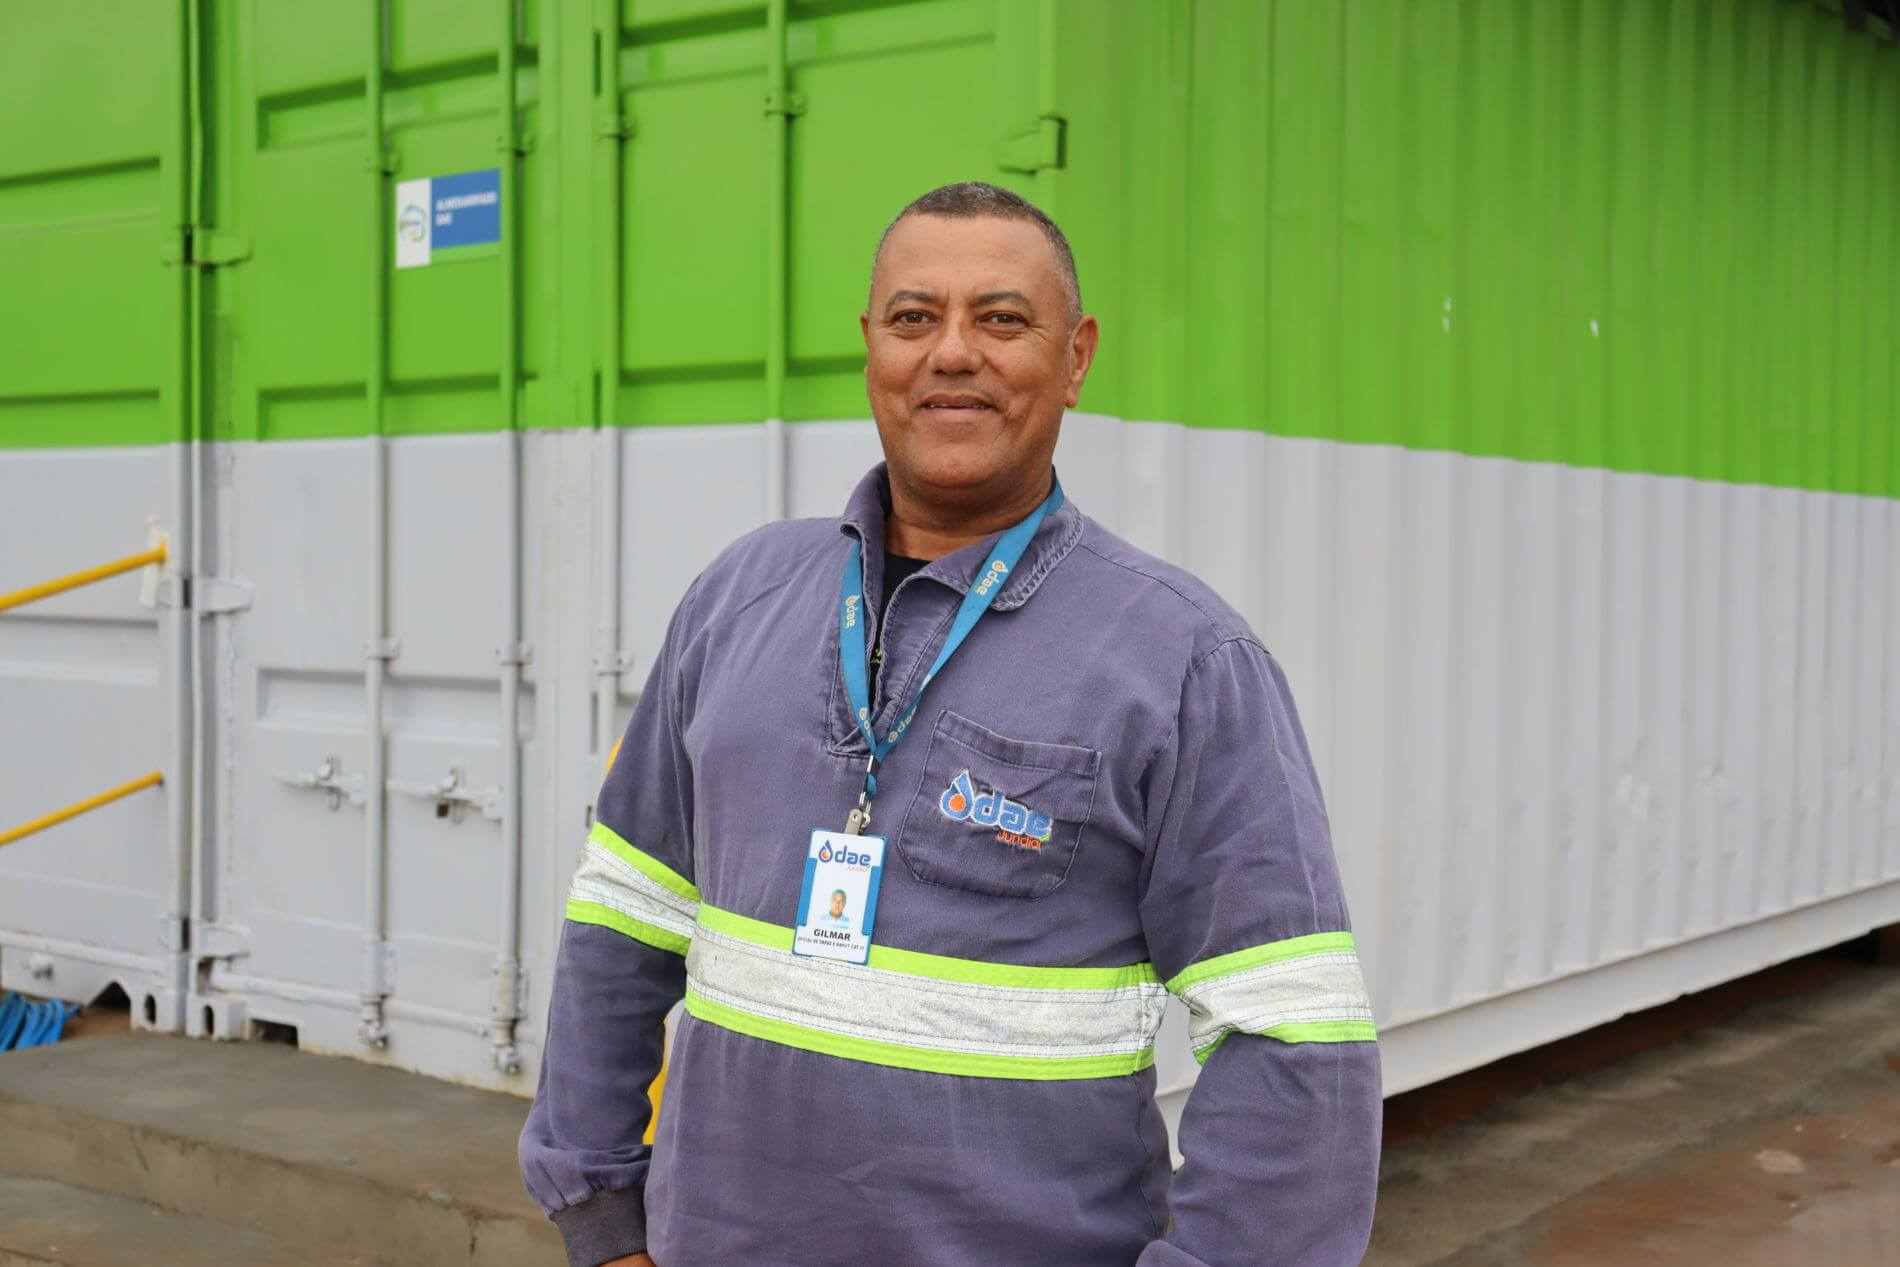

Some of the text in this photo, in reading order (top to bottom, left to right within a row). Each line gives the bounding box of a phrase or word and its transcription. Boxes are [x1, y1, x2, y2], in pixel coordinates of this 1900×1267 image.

[973, 787, 1053, 839] dae
[834, 845, 871, 866] dae
[813, 928, 851, 941] GILMAR
